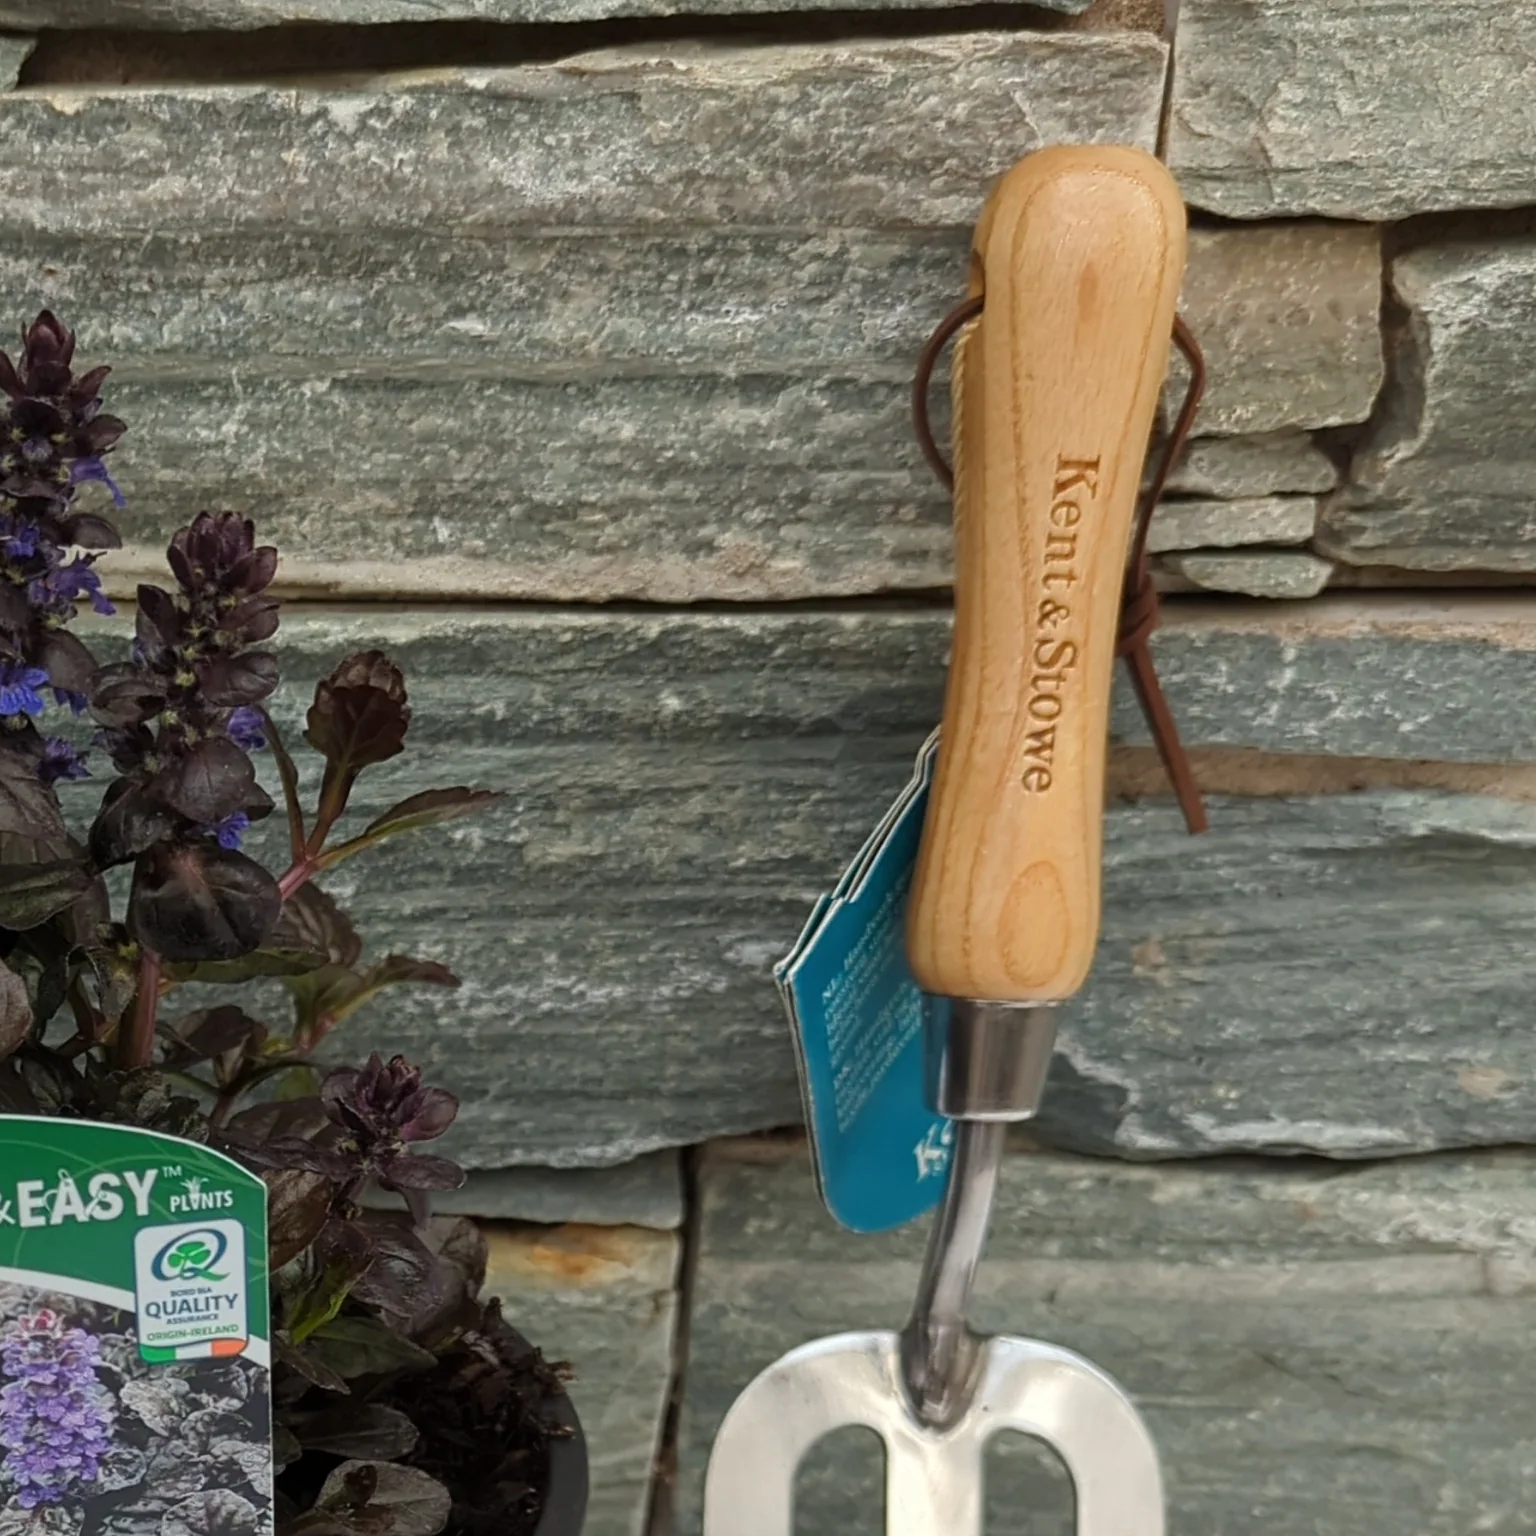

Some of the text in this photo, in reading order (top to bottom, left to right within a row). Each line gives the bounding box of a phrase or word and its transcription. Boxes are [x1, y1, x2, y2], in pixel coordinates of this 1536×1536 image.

[1021, 453, 1101, 794] Kent & Stowe
[145, 1293, 239, 1320] QUALITY
[166, 1313, 219, 1325] ASSURANCE
[147, 1323, 240, 1342] ORIGIN-IRELAND
